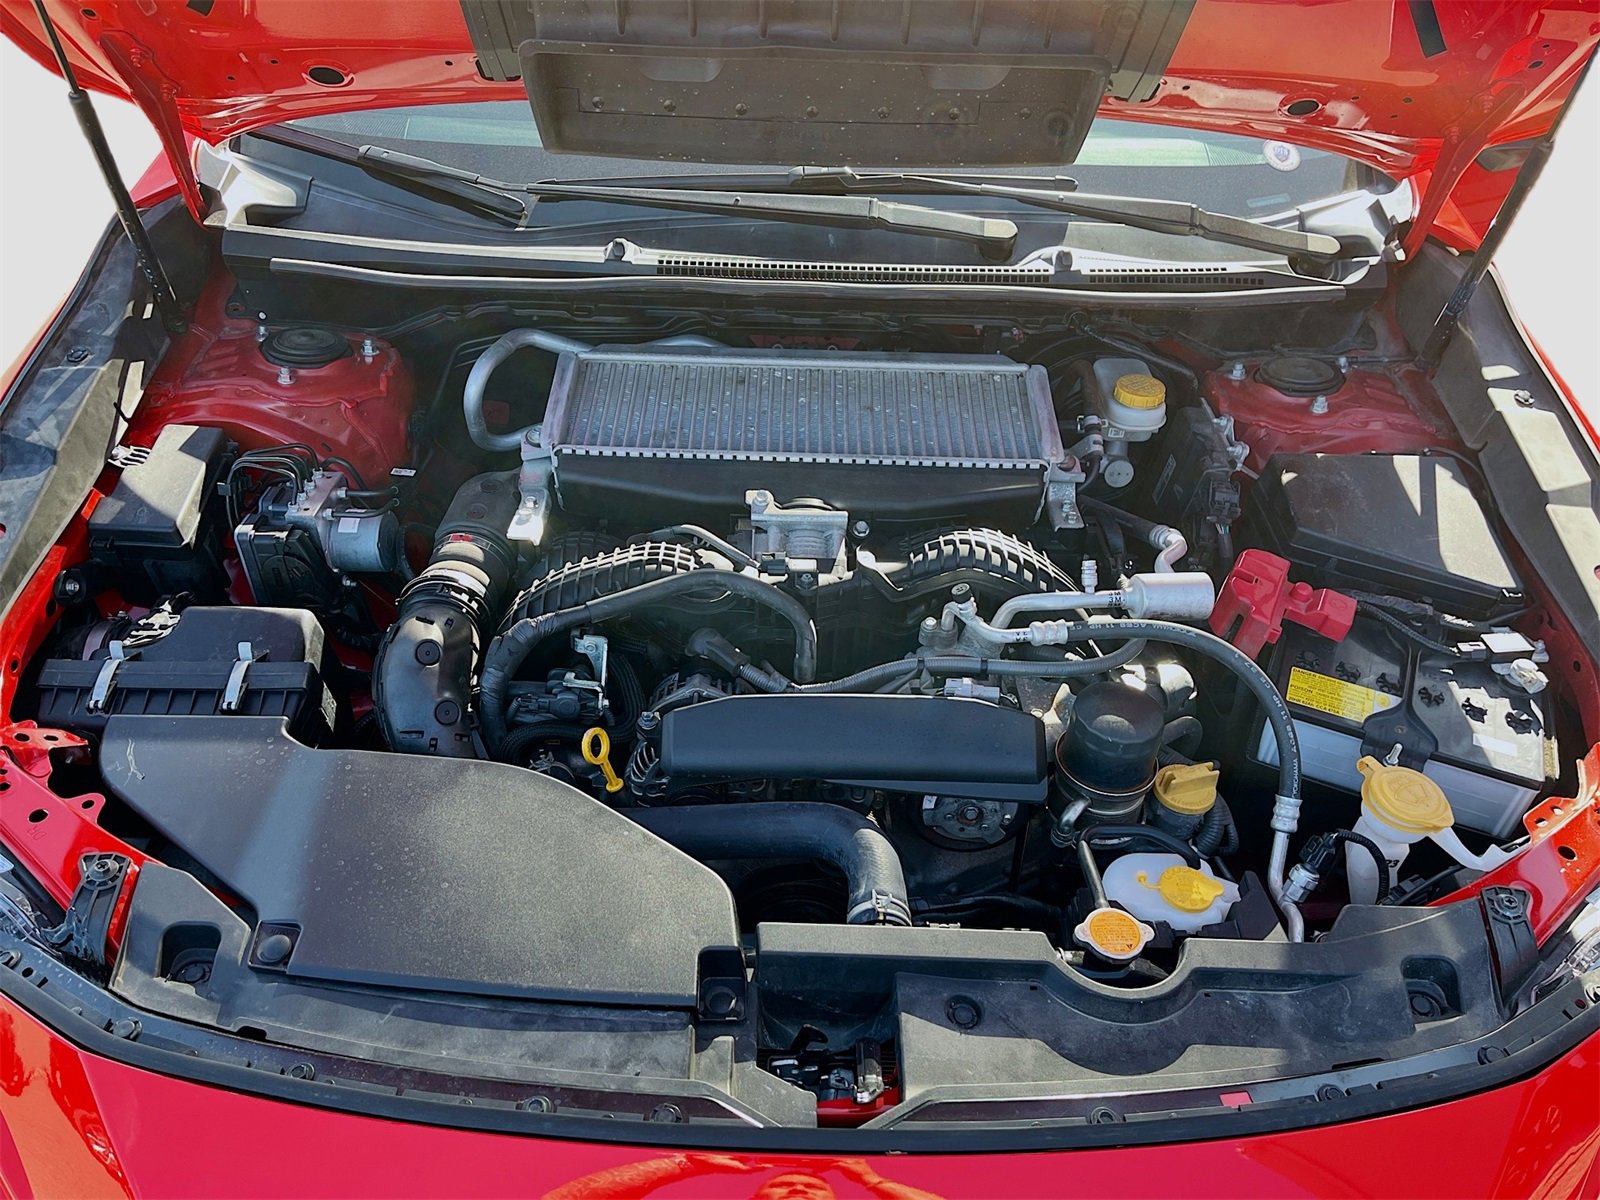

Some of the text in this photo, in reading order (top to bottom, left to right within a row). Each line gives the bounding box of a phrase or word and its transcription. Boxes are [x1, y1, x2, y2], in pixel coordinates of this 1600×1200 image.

[1289, 683, 1313, 694] POISON
[1272, 694, 1282, 708] HP
[1291, 758, 1299, 795] YOKOHAMA
